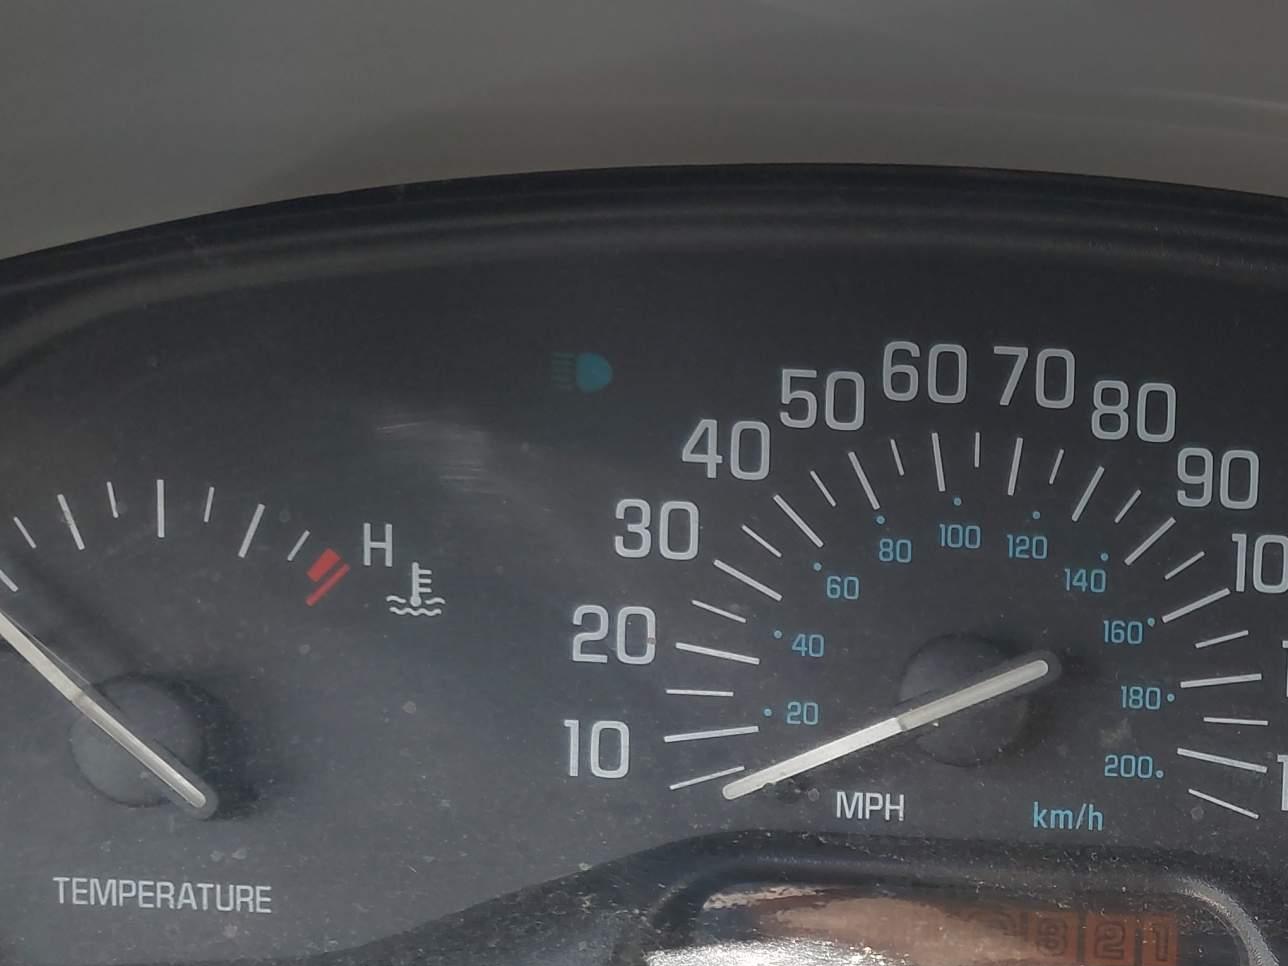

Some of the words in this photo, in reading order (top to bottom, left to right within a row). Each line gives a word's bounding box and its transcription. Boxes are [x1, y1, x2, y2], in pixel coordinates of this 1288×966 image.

[883, 341, 967, 403] 60
[994, 346, 1074, 408] 70
[780, 369, 864, 430] 50
[1092, 380, 1176, 442] 80
[682, 419, 769, 480] 40
[1178, 448, 1259, 509] 90
[615, 499, 698, 560] 30
[940, 524, 980, 548] 100
[364, 523, 392, 566] H
[879, 539, 911, 562] 80
[1008, 535, 1047, 559] 120
[827, 576, 859, 599] 60
[1065, 569, 1105, 592] 140
[573, 605, 655, 664] 20
[792, 634, 824, 657] 40
[1104, 620, 1142, 644] 160
[1121, 686, 1160, 709] 180
[787, 702, 818, 724] 20
[564, 720, 629, 778] 10
[1105, 755, 1152, 778] 200
[837, 792, 904, 821] MPH
[1034, 802, 1102, 830] km/h
[53, 877, 271, 913] TEMPERATURE
